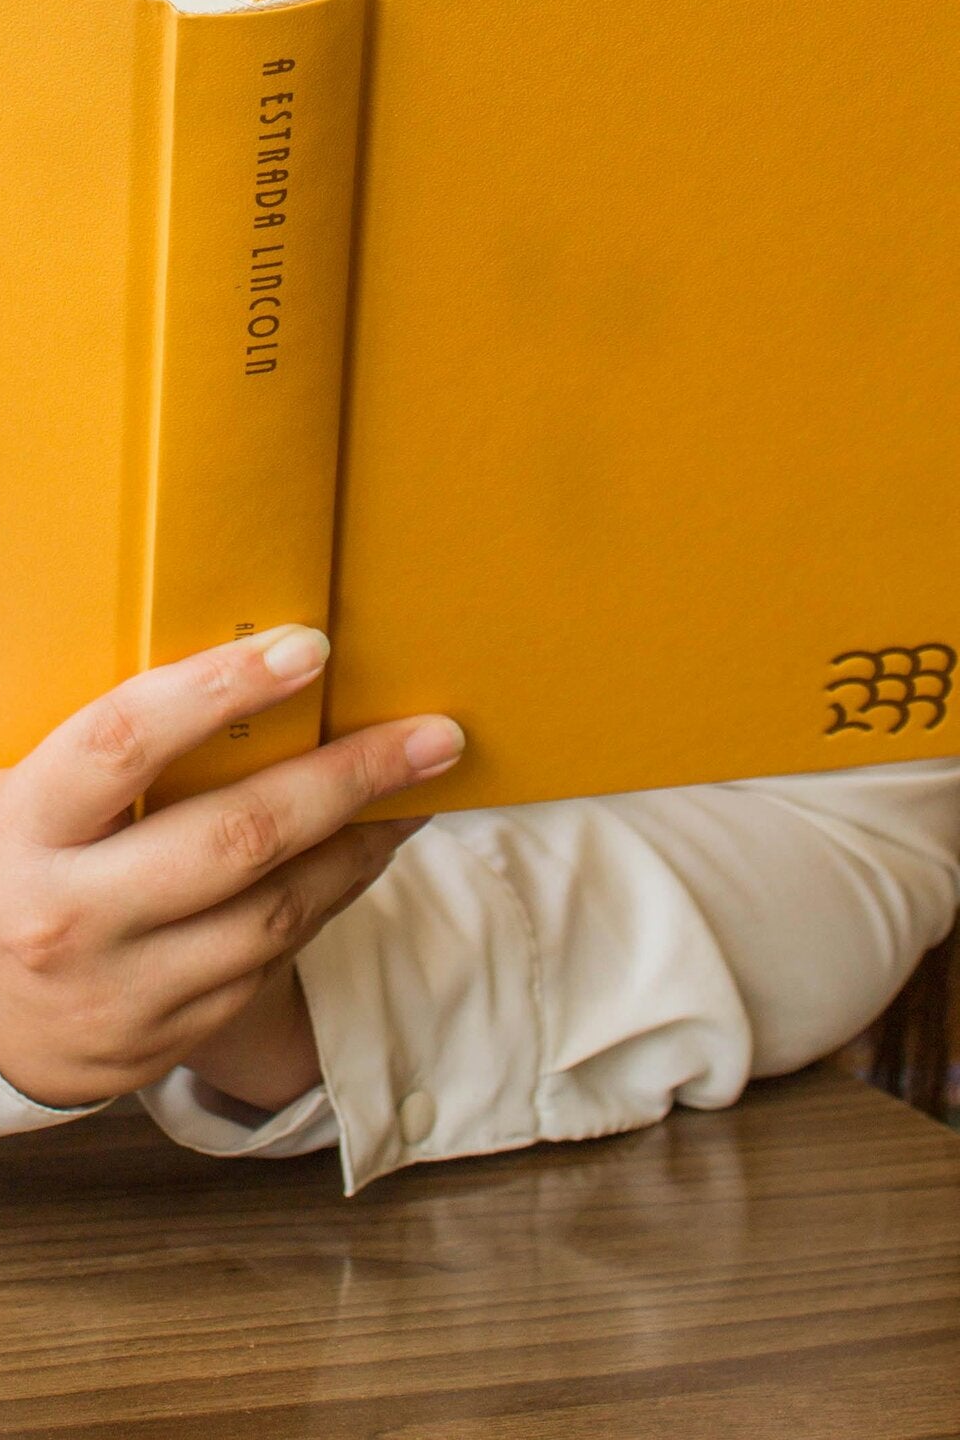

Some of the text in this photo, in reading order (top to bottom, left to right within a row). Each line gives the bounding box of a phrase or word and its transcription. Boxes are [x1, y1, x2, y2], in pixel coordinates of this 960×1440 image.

[245, 58, 296, 375] A ESTRADA LINCOLN
